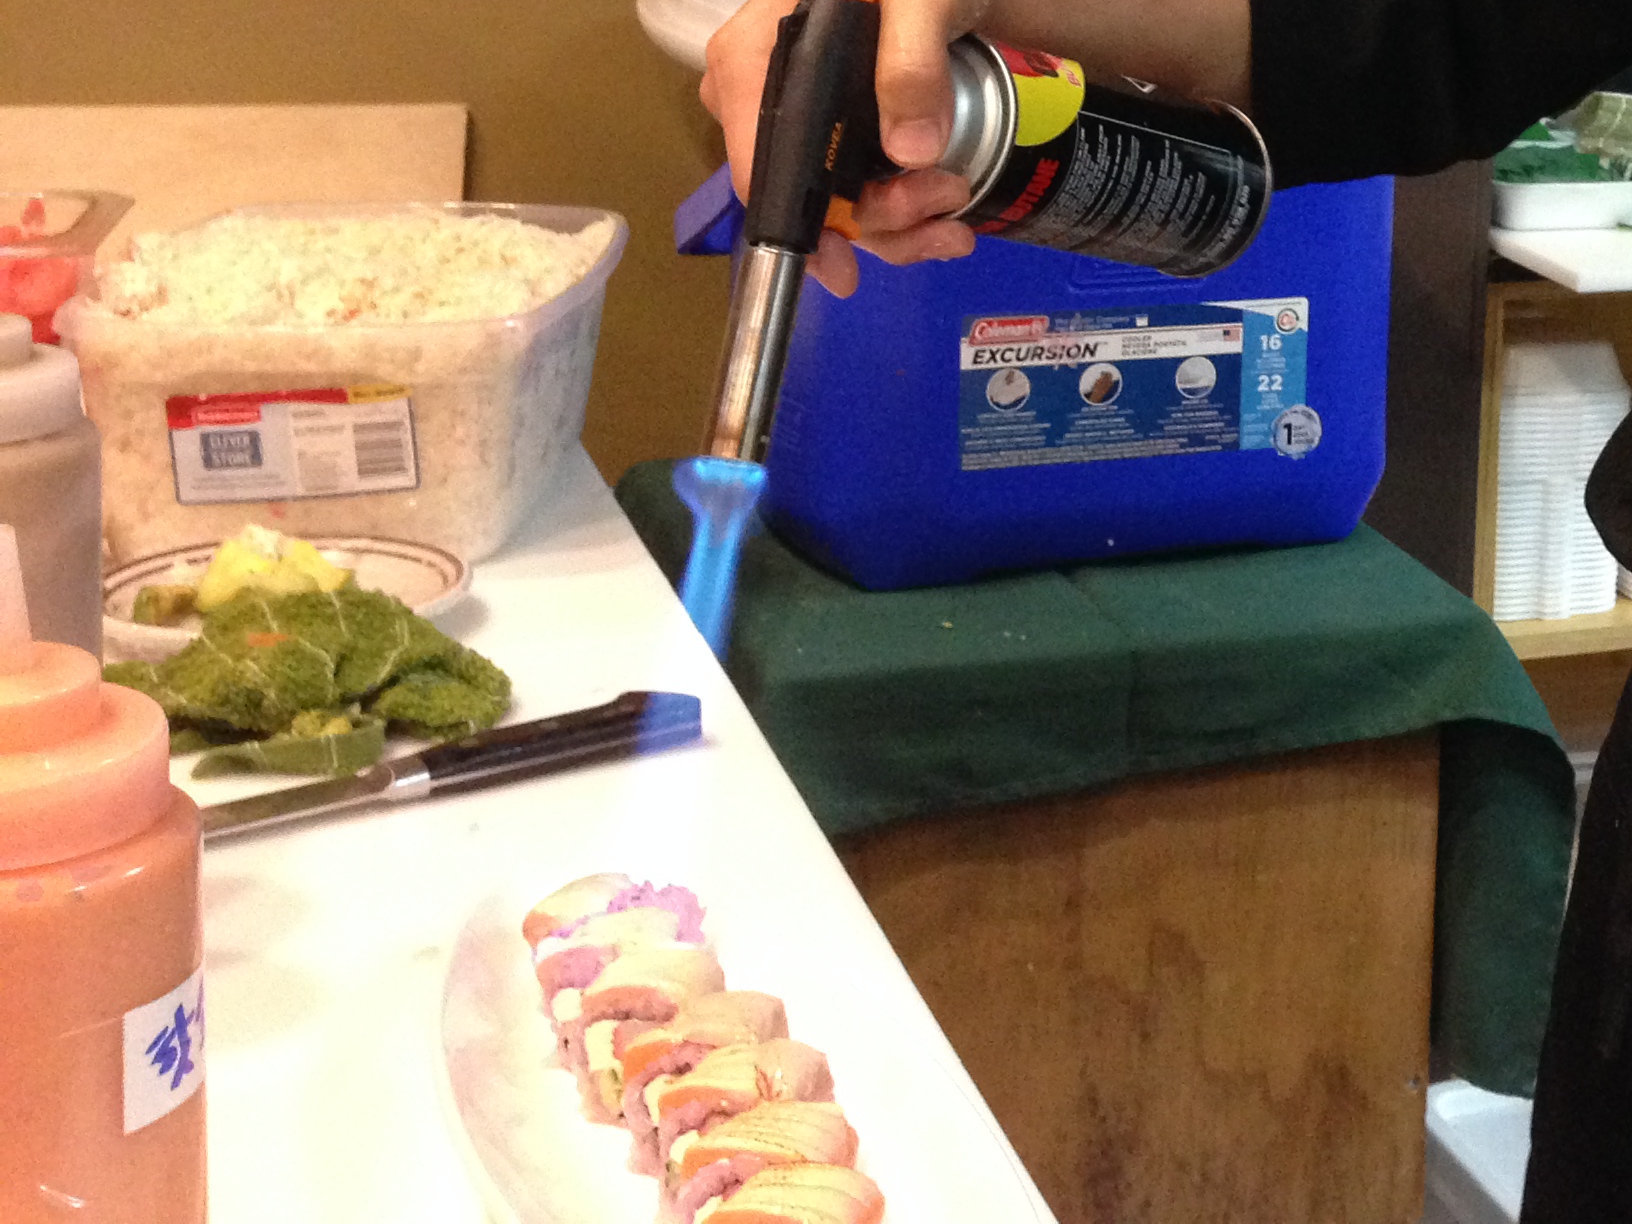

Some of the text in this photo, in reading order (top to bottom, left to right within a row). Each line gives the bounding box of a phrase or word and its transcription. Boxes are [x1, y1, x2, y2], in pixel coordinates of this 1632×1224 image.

[825, 122, 843, 170] KOVEA
[1000, 158, 1060, 221] BUTANE
[1260, 334, 1282, 350] 16
[972, 343, 1099, 365] EXCURSION
[1257, 374, 1283, 392] 22
[1283, 423, 1293, 445] 1
